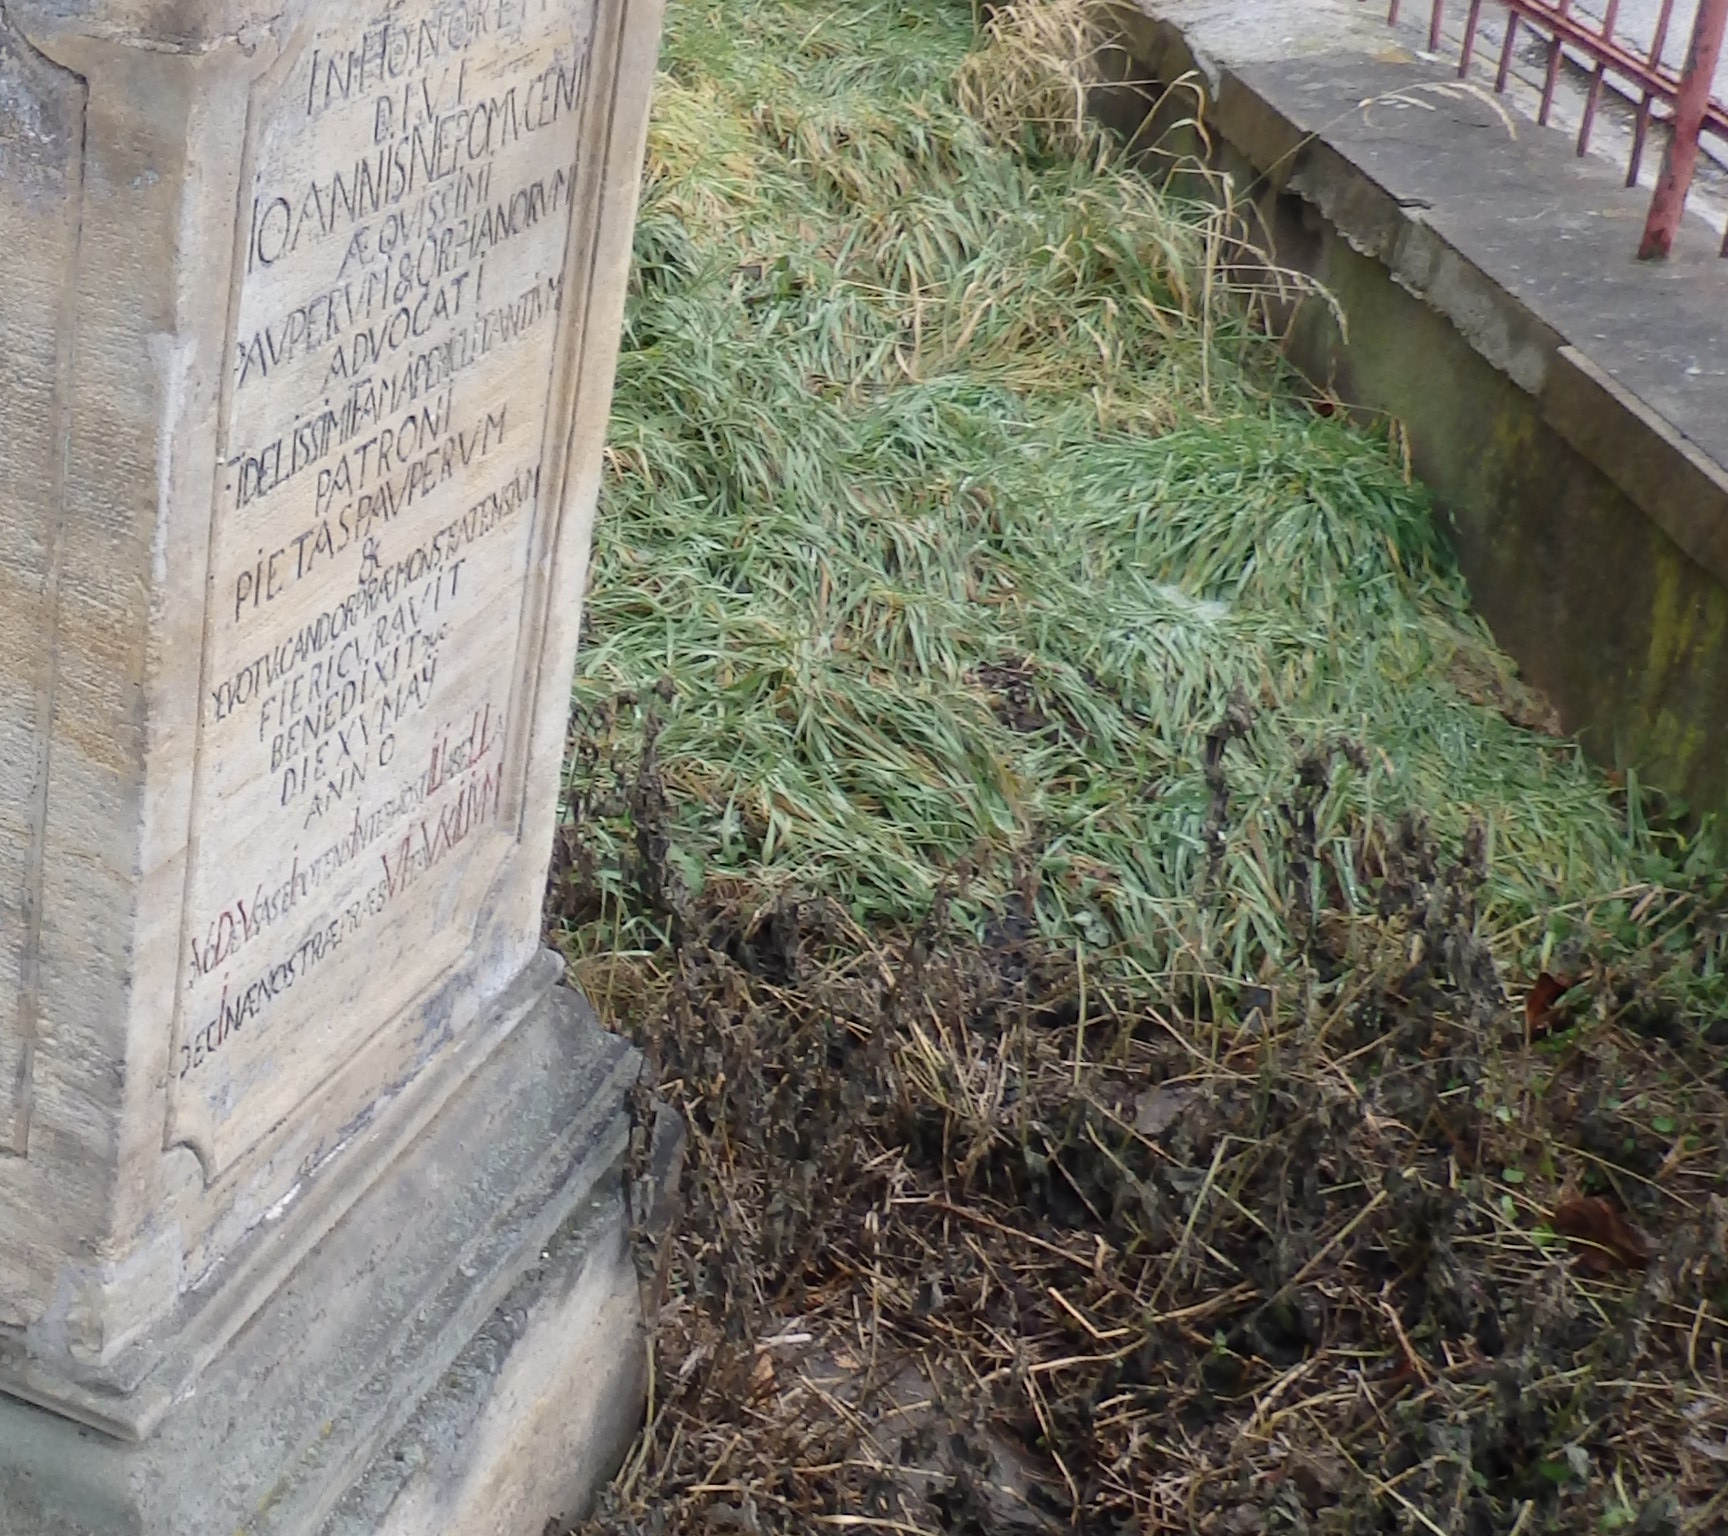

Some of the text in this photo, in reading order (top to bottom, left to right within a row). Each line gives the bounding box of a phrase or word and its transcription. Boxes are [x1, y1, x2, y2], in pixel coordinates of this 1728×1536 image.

[320, 250, 485, 393] ADVOCATI
[314, 377, 453, 519] PATRONI
[357, 538, 382, 589] &
[302, 727, 397, 832] ANNO
